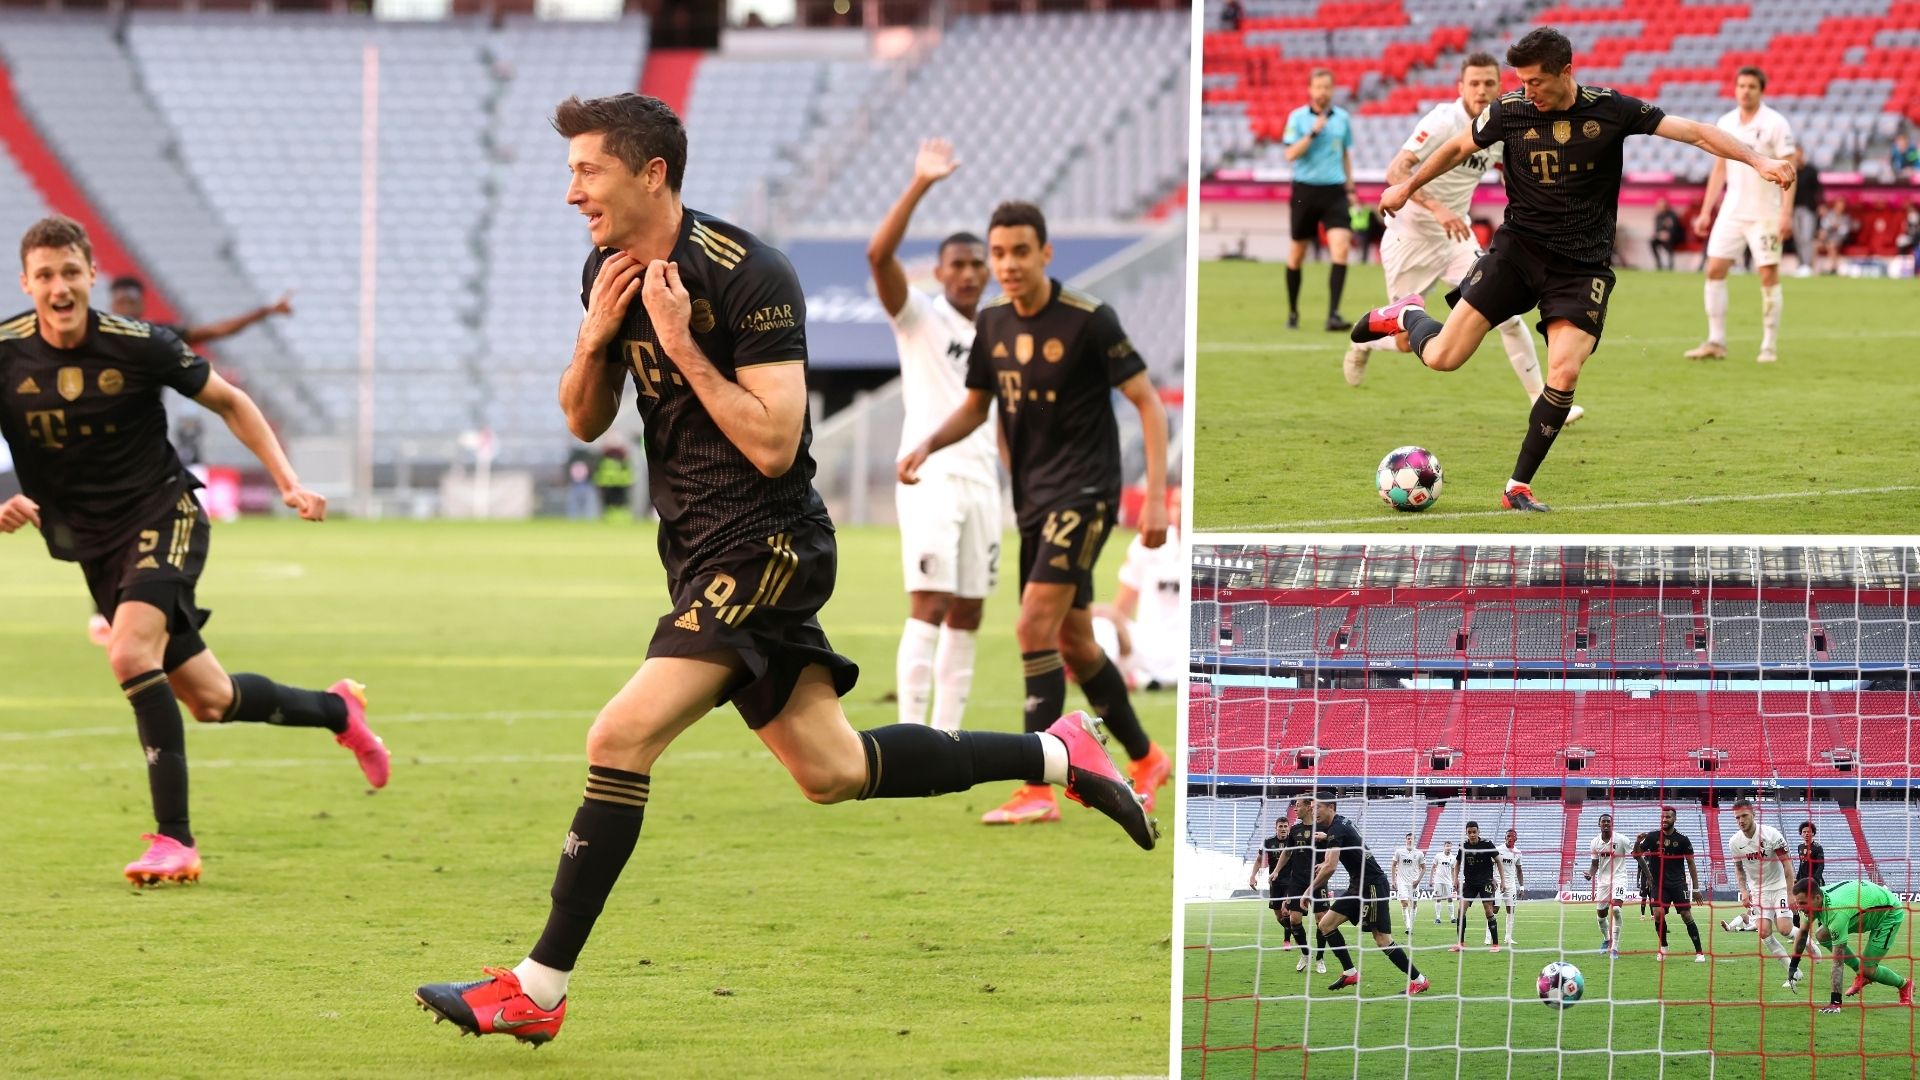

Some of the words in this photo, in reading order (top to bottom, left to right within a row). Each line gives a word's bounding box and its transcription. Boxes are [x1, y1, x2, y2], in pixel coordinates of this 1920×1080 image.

[1591, 277, 1606, 304] 9
[754, 319, 795, 332] AIRWAYS
[1042, 510, 1081, 548] 42
[674, 620, 700, 632] adidas
[1746, 850, 1768, 860] WWK
[1779, 898, 1786, 909] 6
